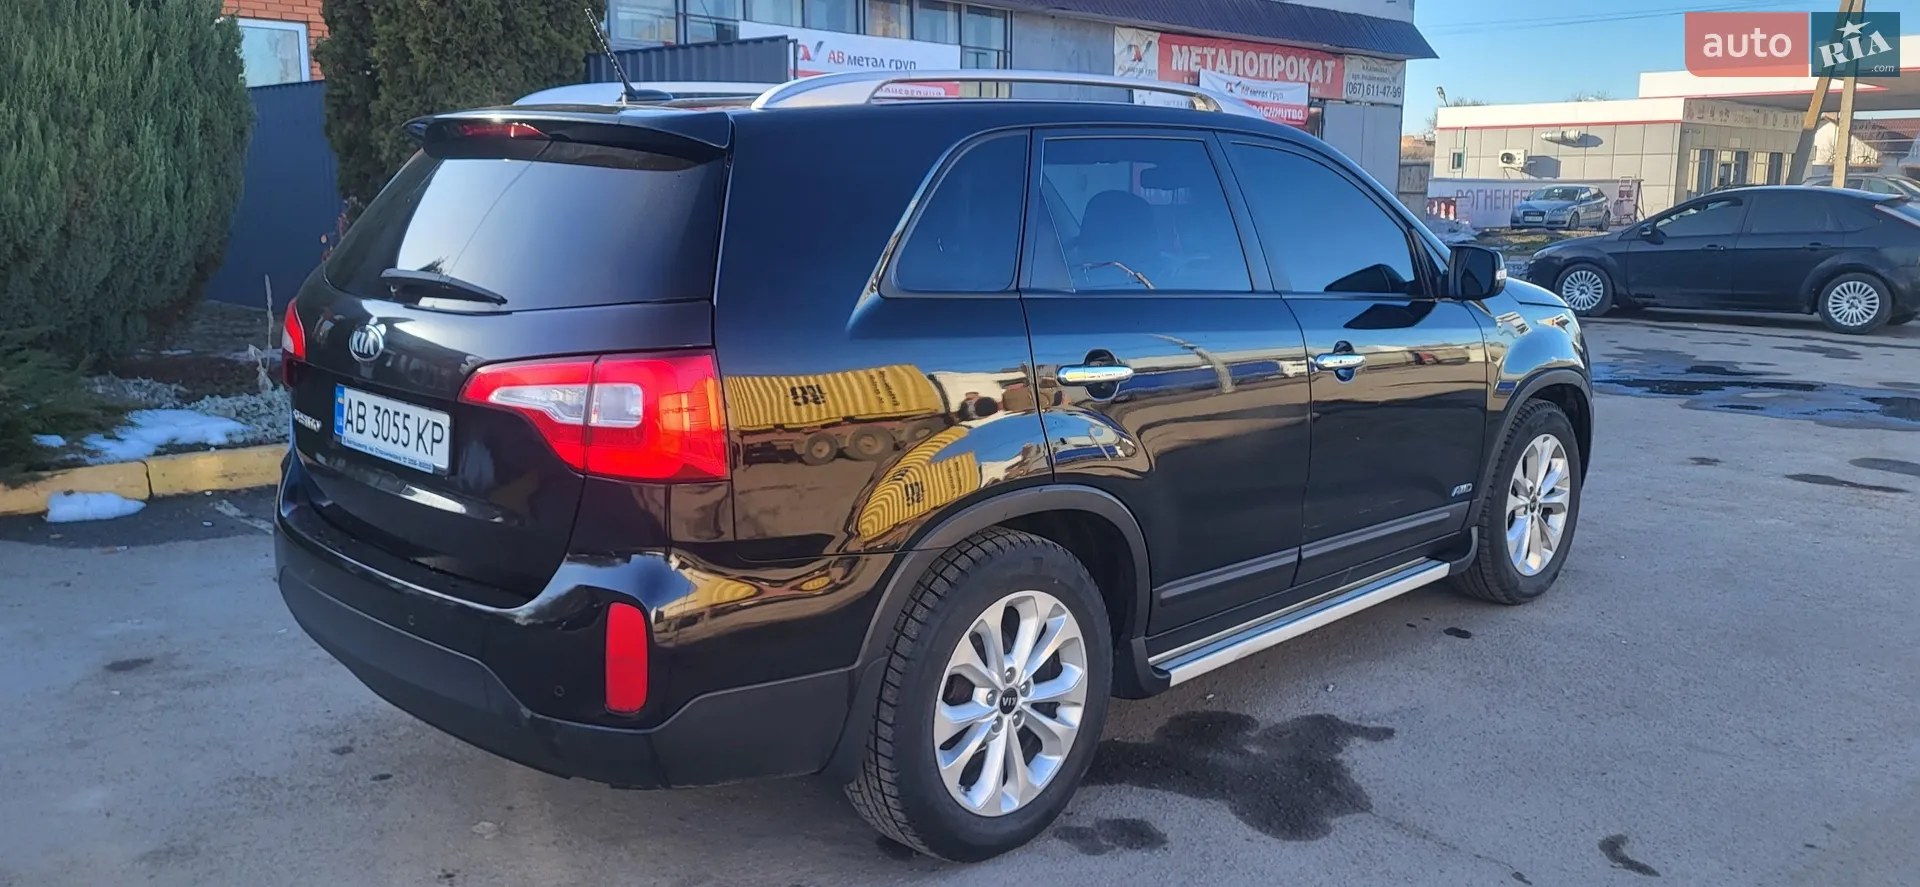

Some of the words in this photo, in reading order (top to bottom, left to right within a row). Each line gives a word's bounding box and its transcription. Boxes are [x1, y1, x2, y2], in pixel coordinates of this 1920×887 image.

[828, 50, 846, 64] АВ
[846, 54, 886, 68] метал
[1171, 44, 1336, 84] МЕТАЛОПРОКАТ
[1346, 81, 1365, 98] (067)
[351, 330, 376, 356] KIA
[345, 398, 367, 434] AB
[371, 406, 411, 448] 3055
[416, 419, 444, 456] KP
